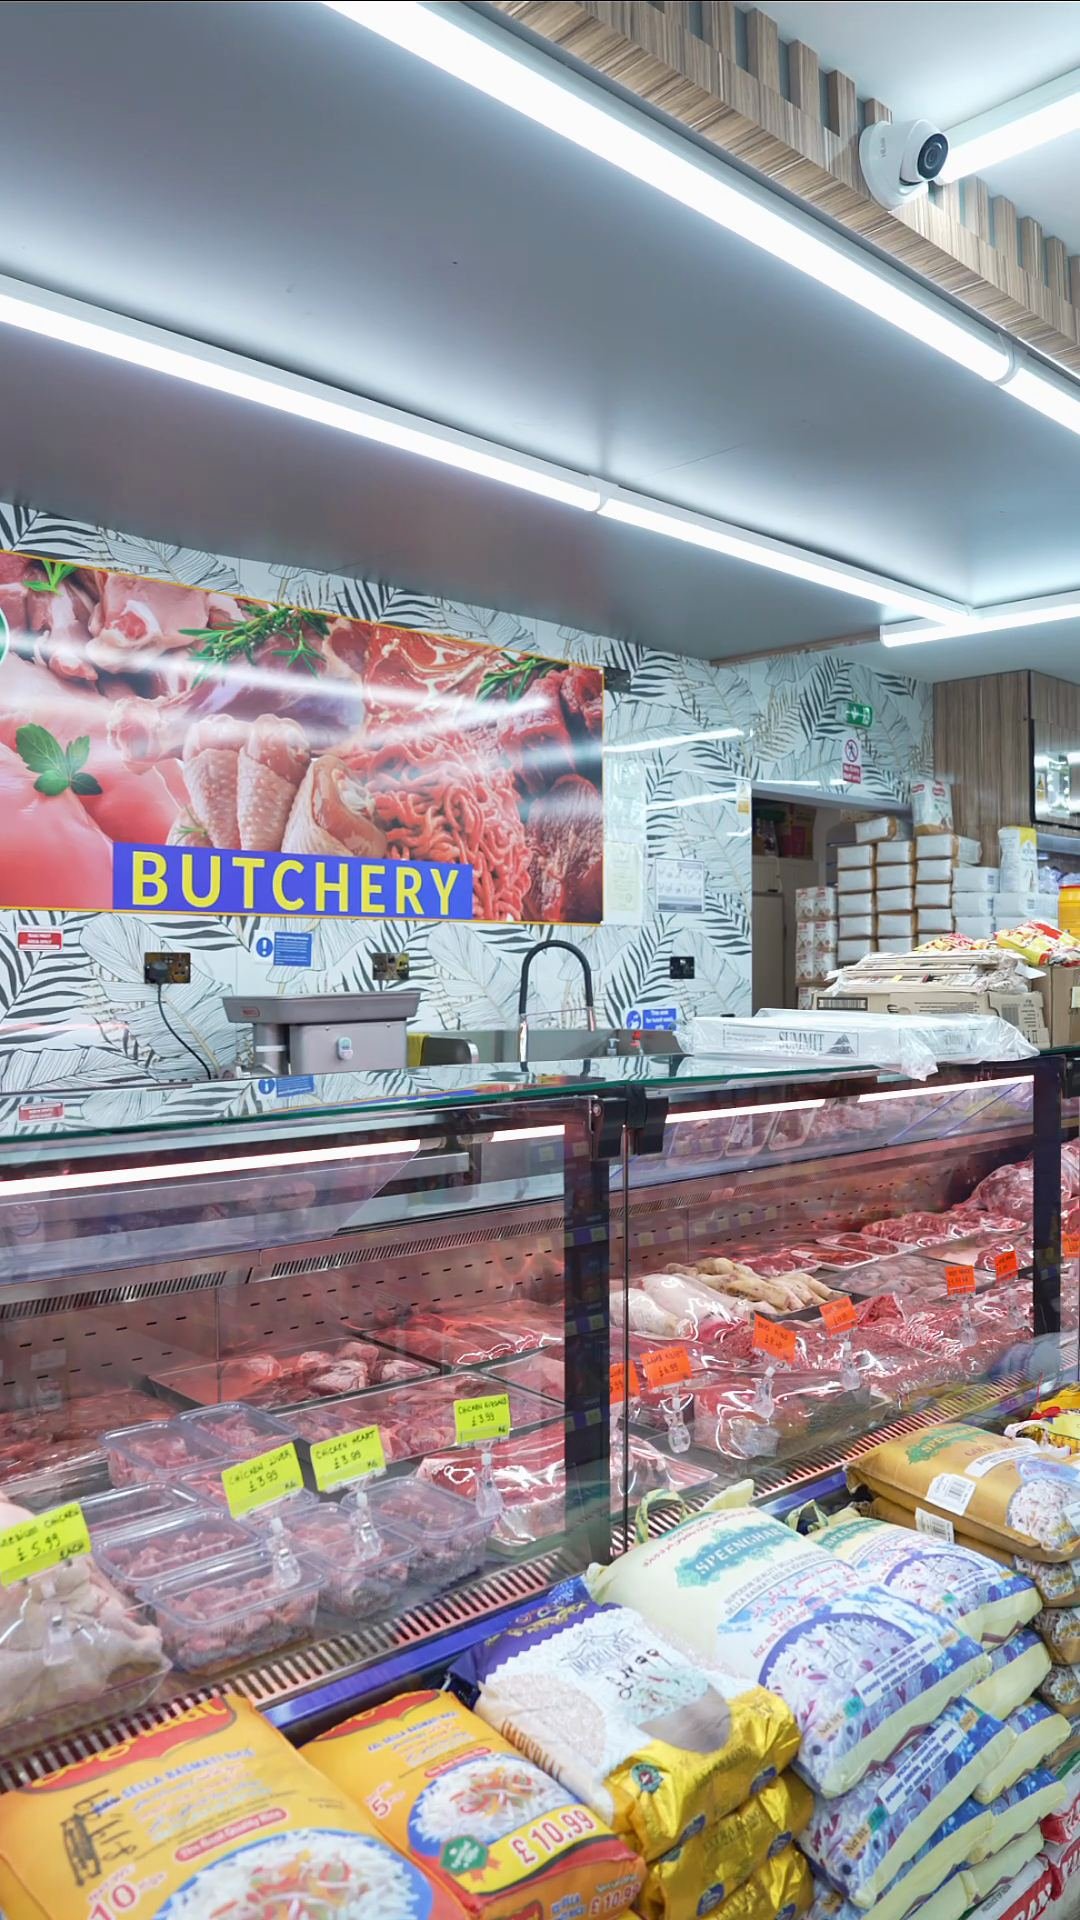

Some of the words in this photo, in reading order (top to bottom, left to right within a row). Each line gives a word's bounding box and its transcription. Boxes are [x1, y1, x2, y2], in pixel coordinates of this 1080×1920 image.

[131, 851, 460, 915] BUTCHERY
[778, 1030, 825, 1051] SUMMIT
[315, 1444, 348, 1460] CHICKEN
[352, 1430, 376, 1444] HEART
[229, 1461, 264, 1485] CHICKEN
[269, 1450, 292, 1466] LIVER
[694, 1527, 786, 1576] SPEENGHAR
[121, 1775, 163, 1799] SELLA
[163, 1756, 223, 1780] BASMATI
[371, 1799, 390, 1817] 5
[531, 1809, 595, 1852] 10.99
